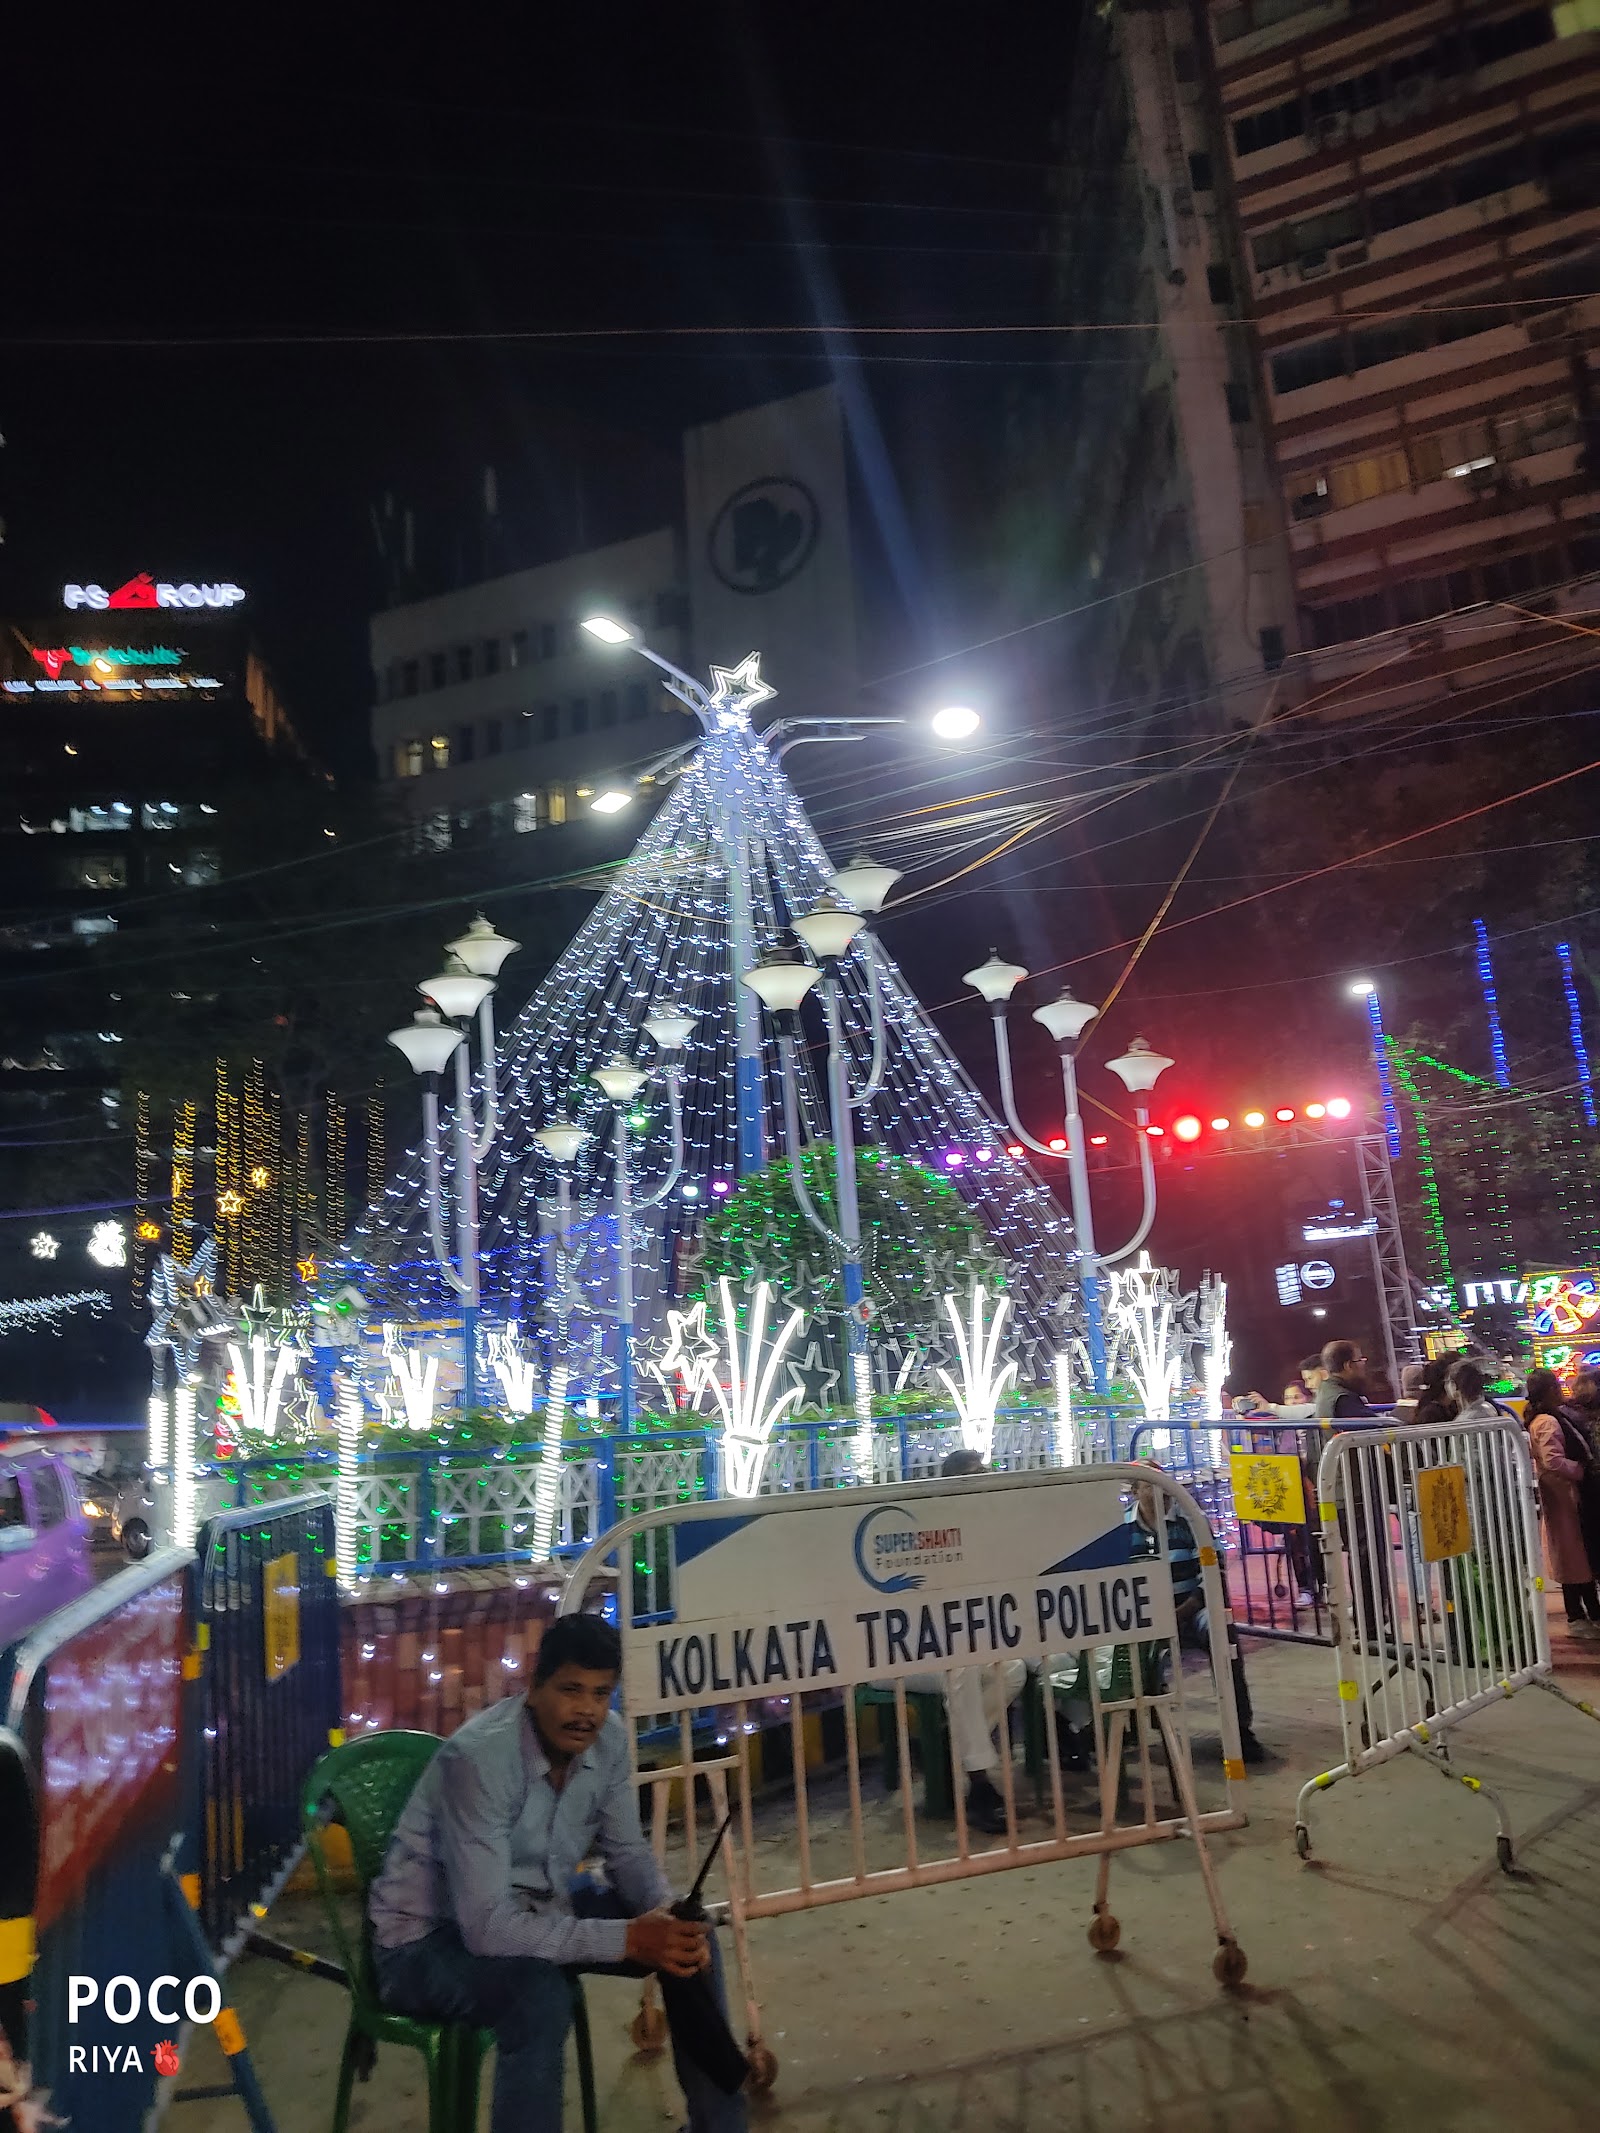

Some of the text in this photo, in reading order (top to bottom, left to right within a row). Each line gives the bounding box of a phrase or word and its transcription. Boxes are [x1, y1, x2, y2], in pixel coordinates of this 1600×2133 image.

[64, 584, 109, 609] PS
[875, 1550, 963, 1570] Foundation
[657, 1576, 1152, 1699] KOLKATA TRAFFIC POLICE
